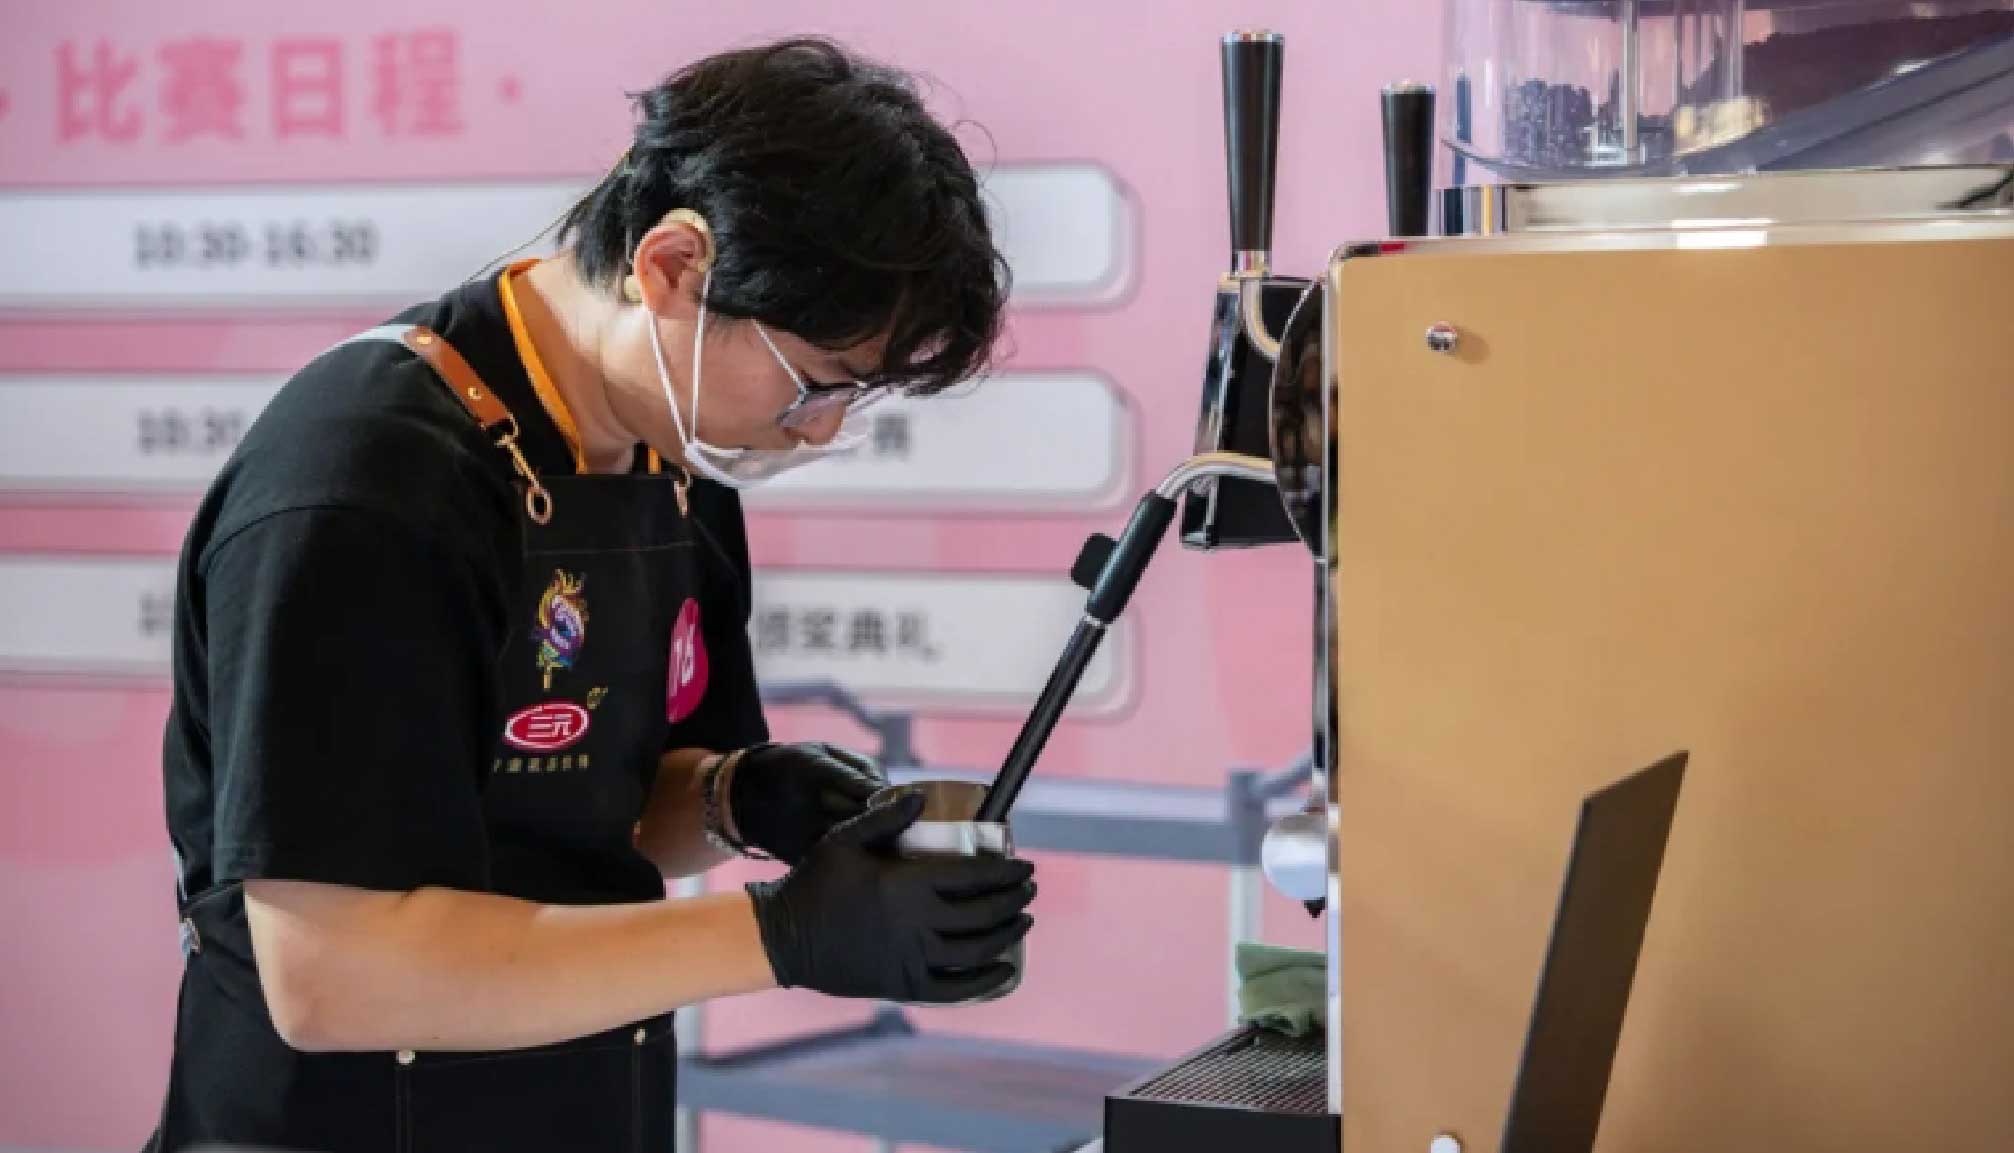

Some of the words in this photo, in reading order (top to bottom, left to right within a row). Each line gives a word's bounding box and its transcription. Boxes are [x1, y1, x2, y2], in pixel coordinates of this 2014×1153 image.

[54, 28, 466, 145] 比赛日程
[527, 713, 572, 738] 三元
